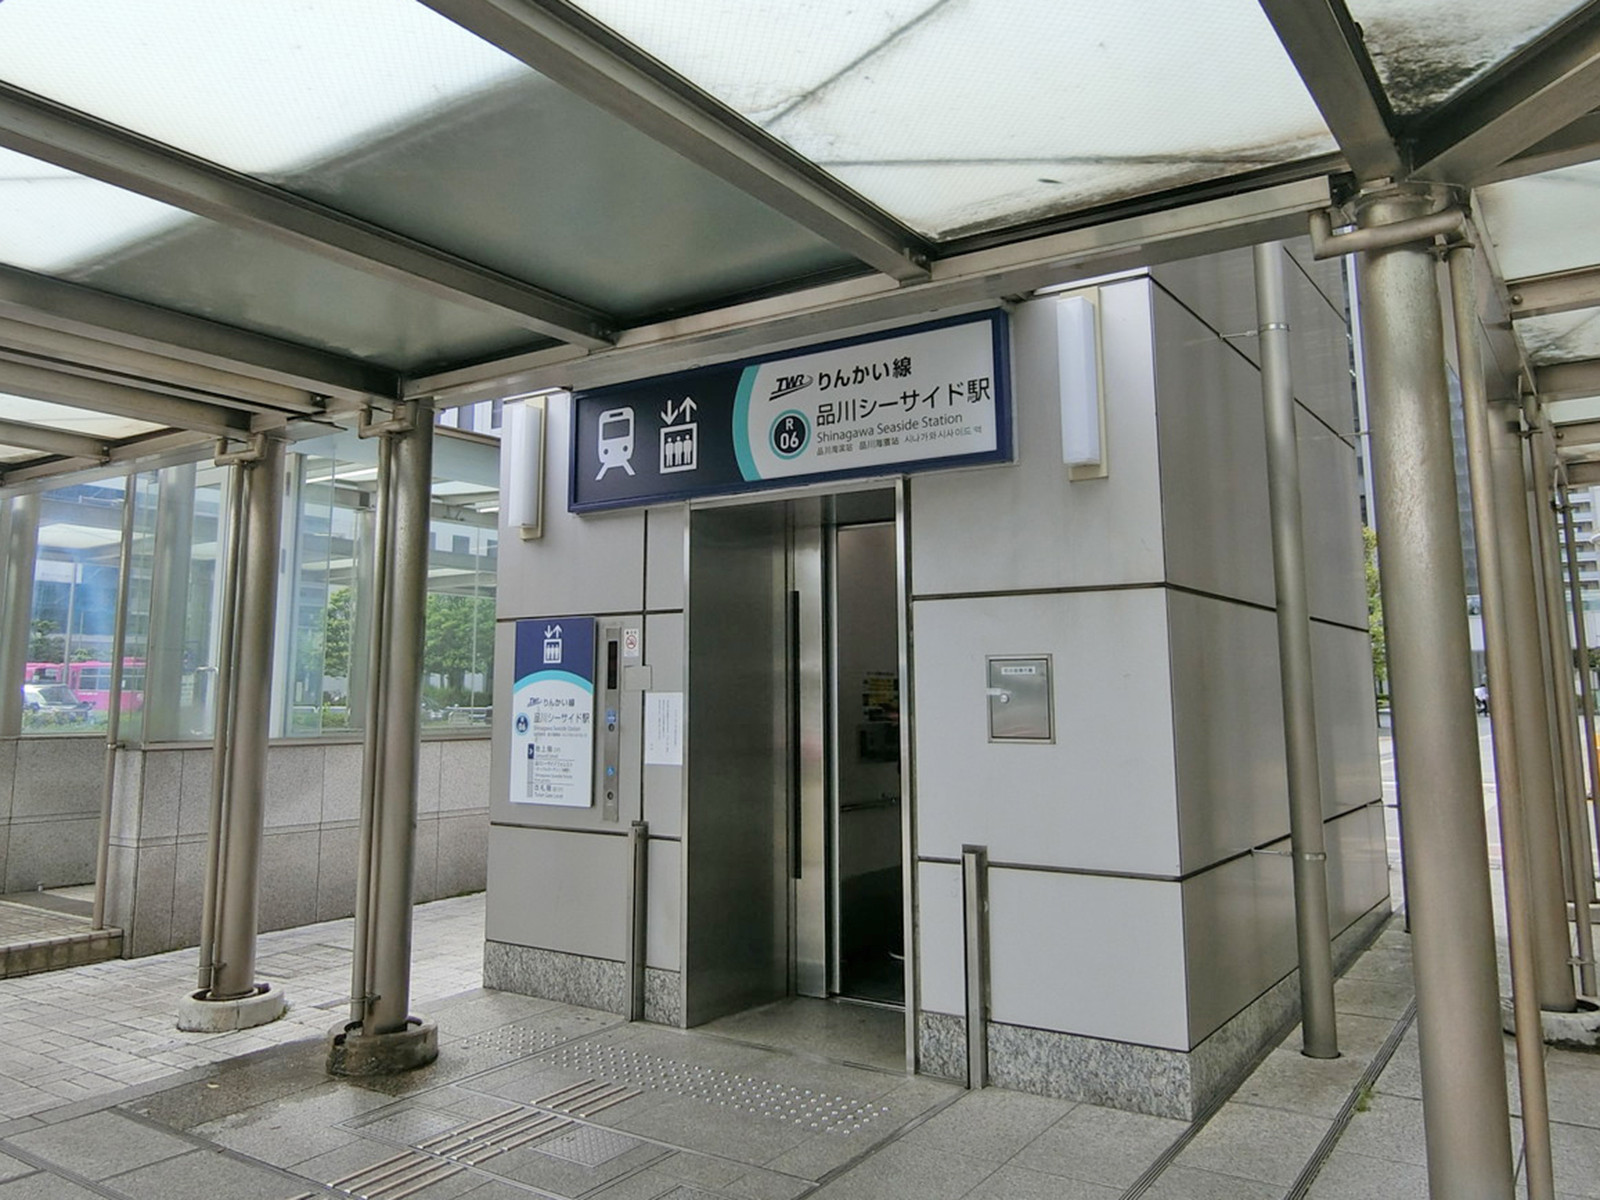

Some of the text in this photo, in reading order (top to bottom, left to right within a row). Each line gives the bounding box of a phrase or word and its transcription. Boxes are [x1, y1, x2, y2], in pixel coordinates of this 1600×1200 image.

[771, 357, 912, 396] TWR りんかい線
[816, 377, 991, 427] 品川シーサイド駅
[785, 418, 794, 430] R
[816, 413, 962, 443] Shinagawa Seaside Station
[780, 431, 799, 449] 06
